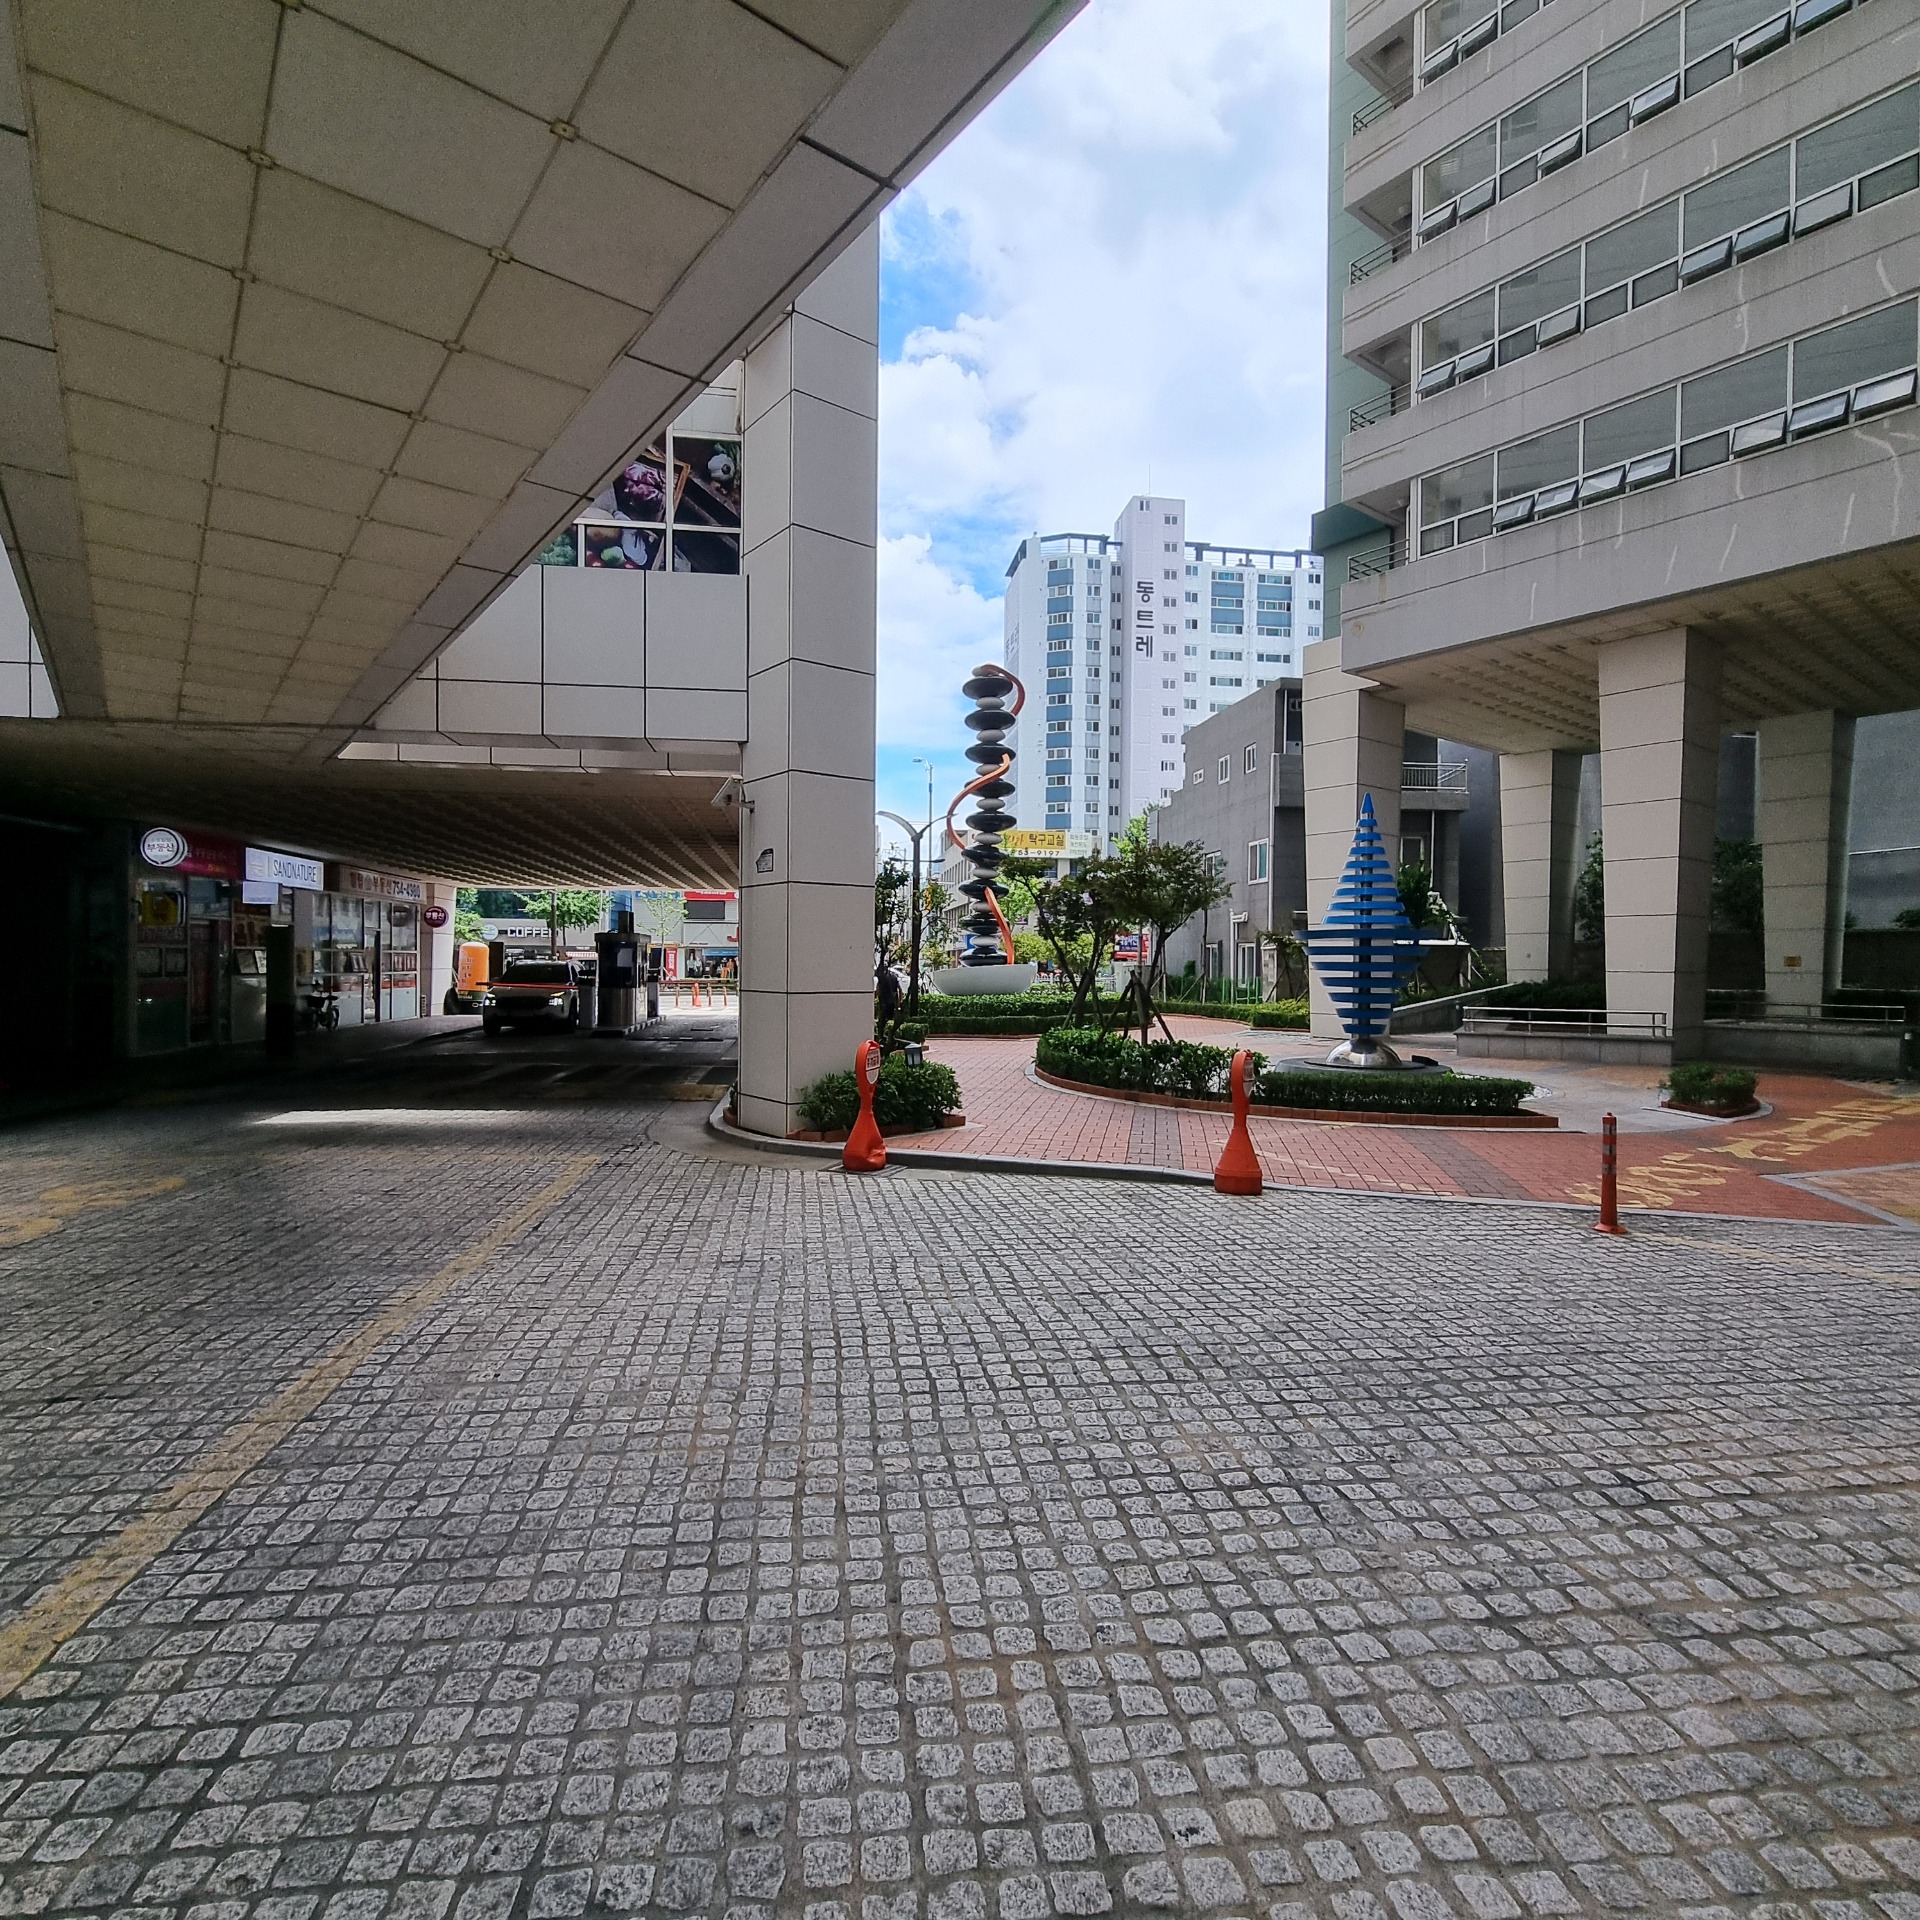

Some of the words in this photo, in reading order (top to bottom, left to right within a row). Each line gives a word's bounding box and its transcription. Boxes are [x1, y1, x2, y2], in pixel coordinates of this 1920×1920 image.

[1135, 580, 1155, 659] 동트레
[1028, 833, 1065, 847] 탁구교실
[146, 843, 175, 853] 부동산
[273, 859, 317, 883] SANDNATURE
[425, 911, 445, 920] 부동산
[507, 926, 553, 938] COFFE
